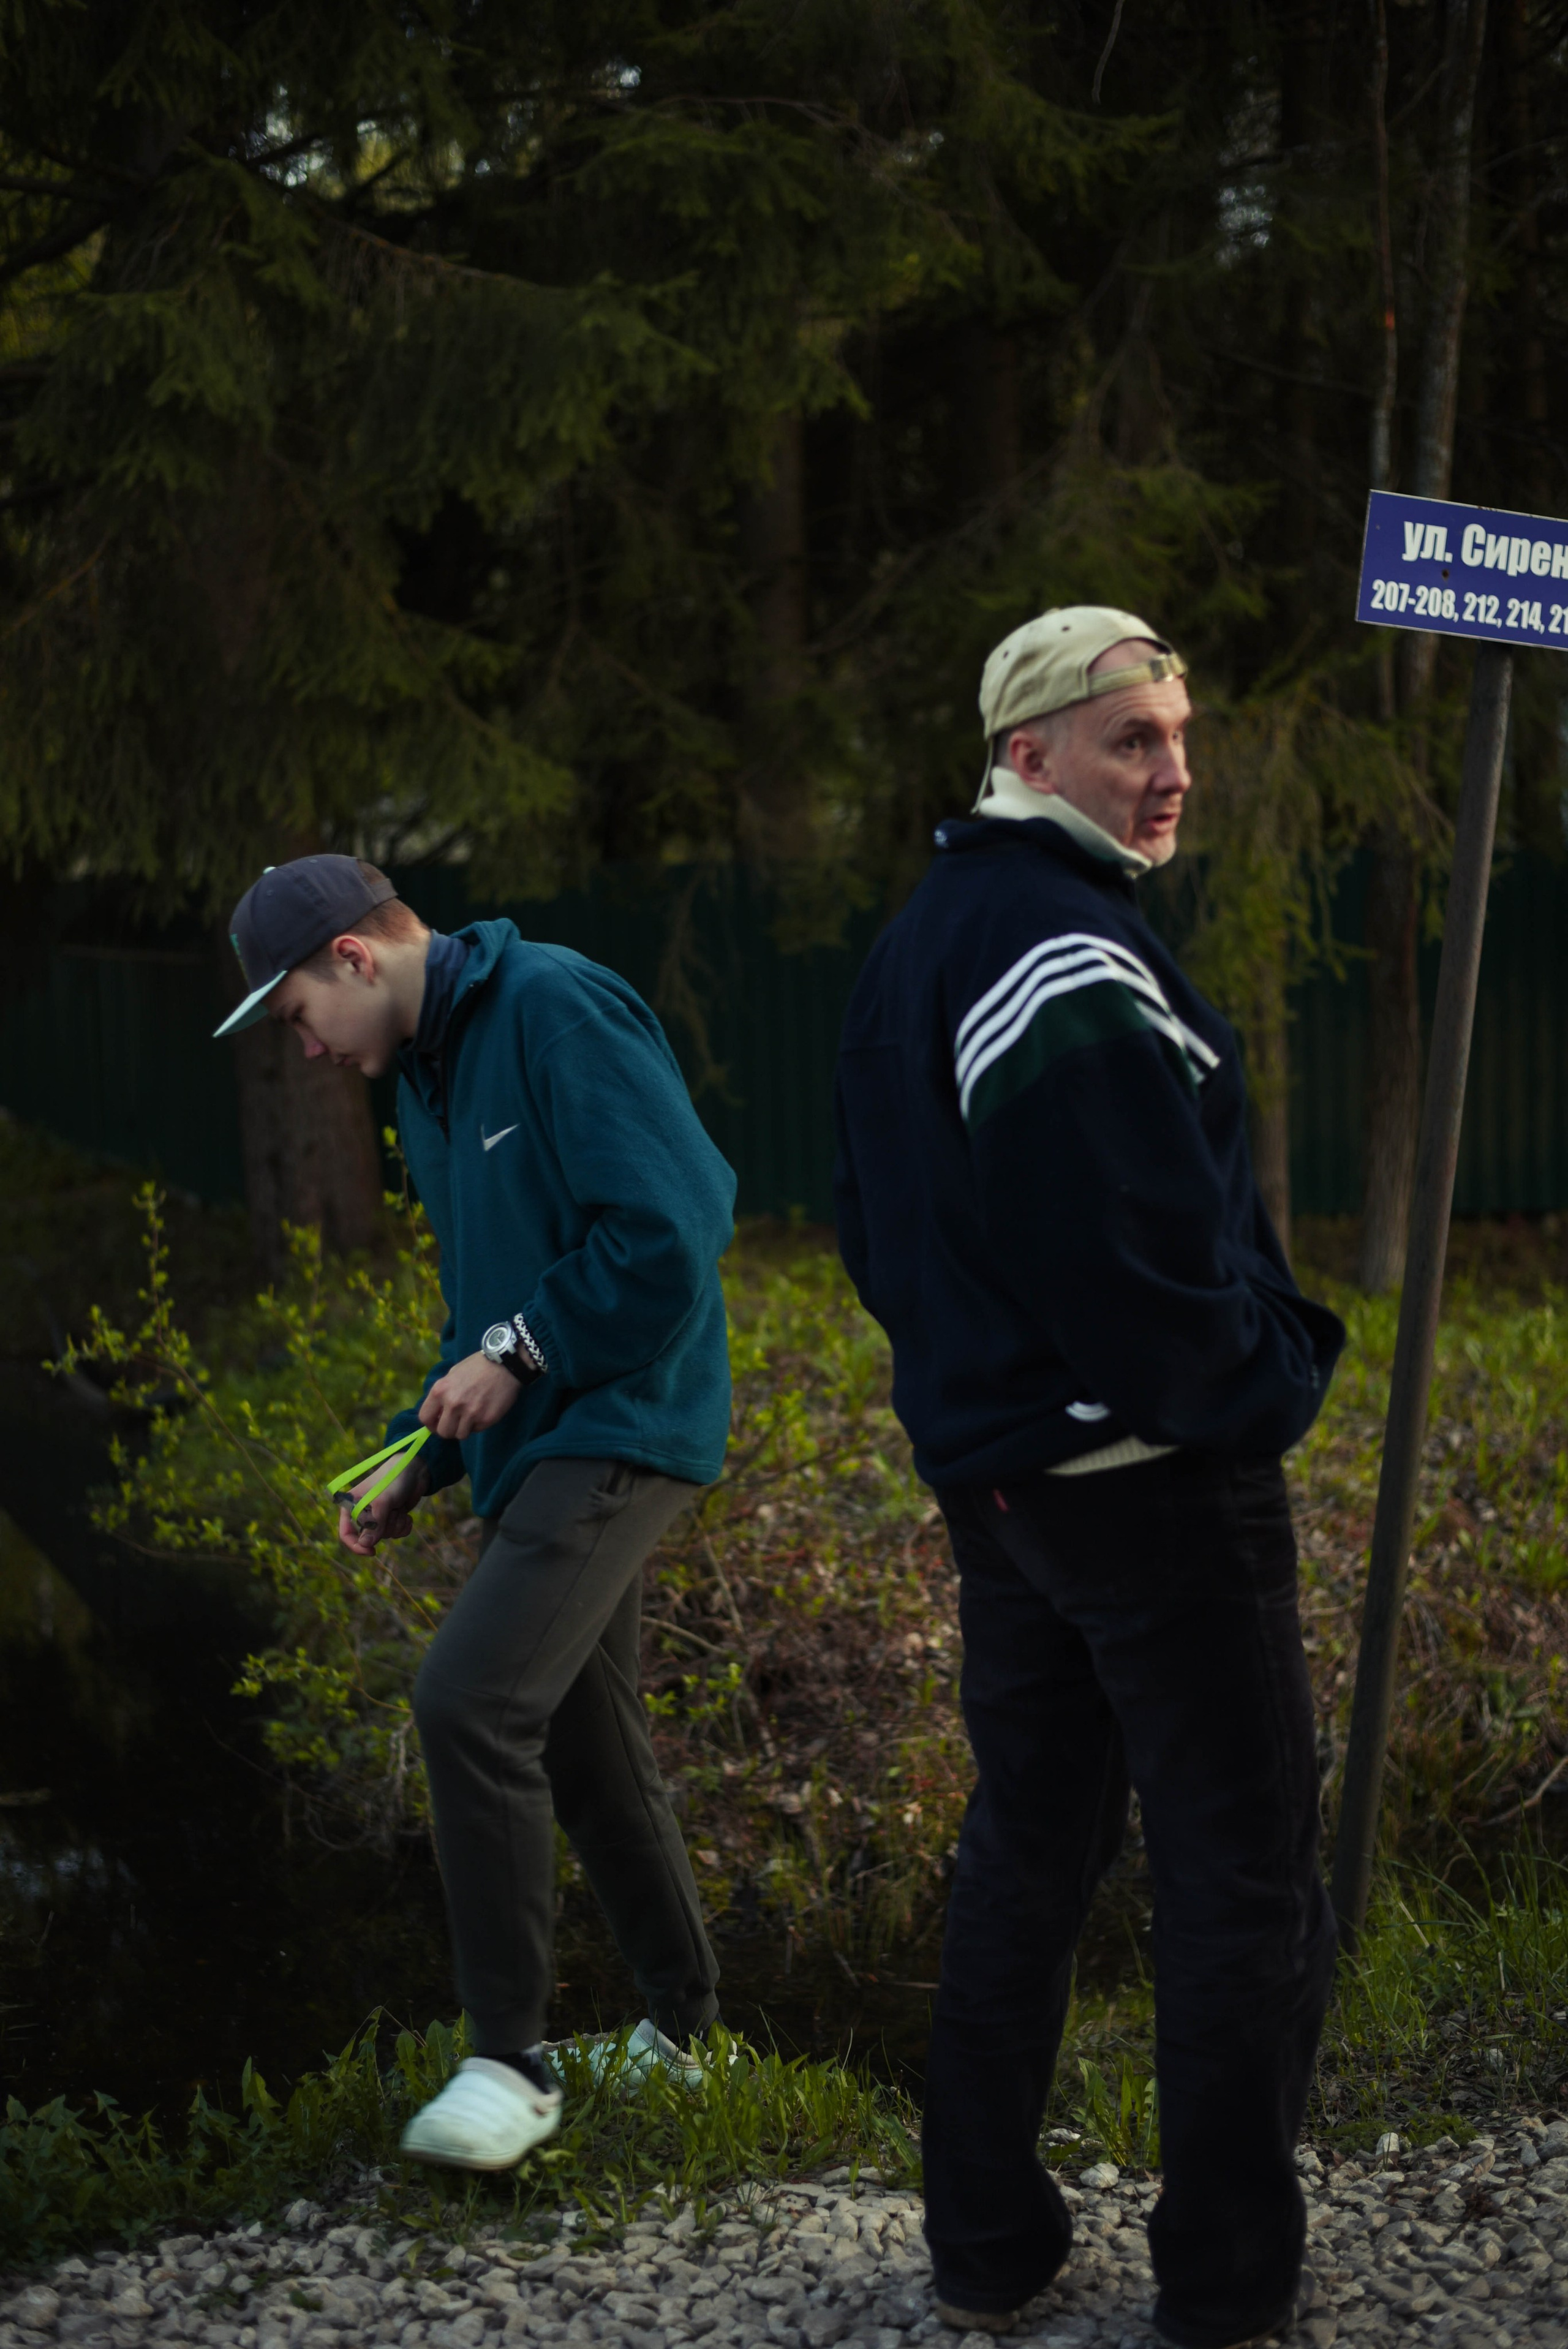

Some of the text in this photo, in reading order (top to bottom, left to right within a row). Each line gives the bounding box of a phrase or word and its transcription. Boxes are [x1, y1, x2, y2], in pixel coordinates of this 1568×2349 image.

[1402, 521, 1568, 579] ул. Сирен
[1371, 579, 1459, 623] 207-208,
[1462, 592, 1502, 628] 212,
[1505, 598, 1545, 634] 214,
